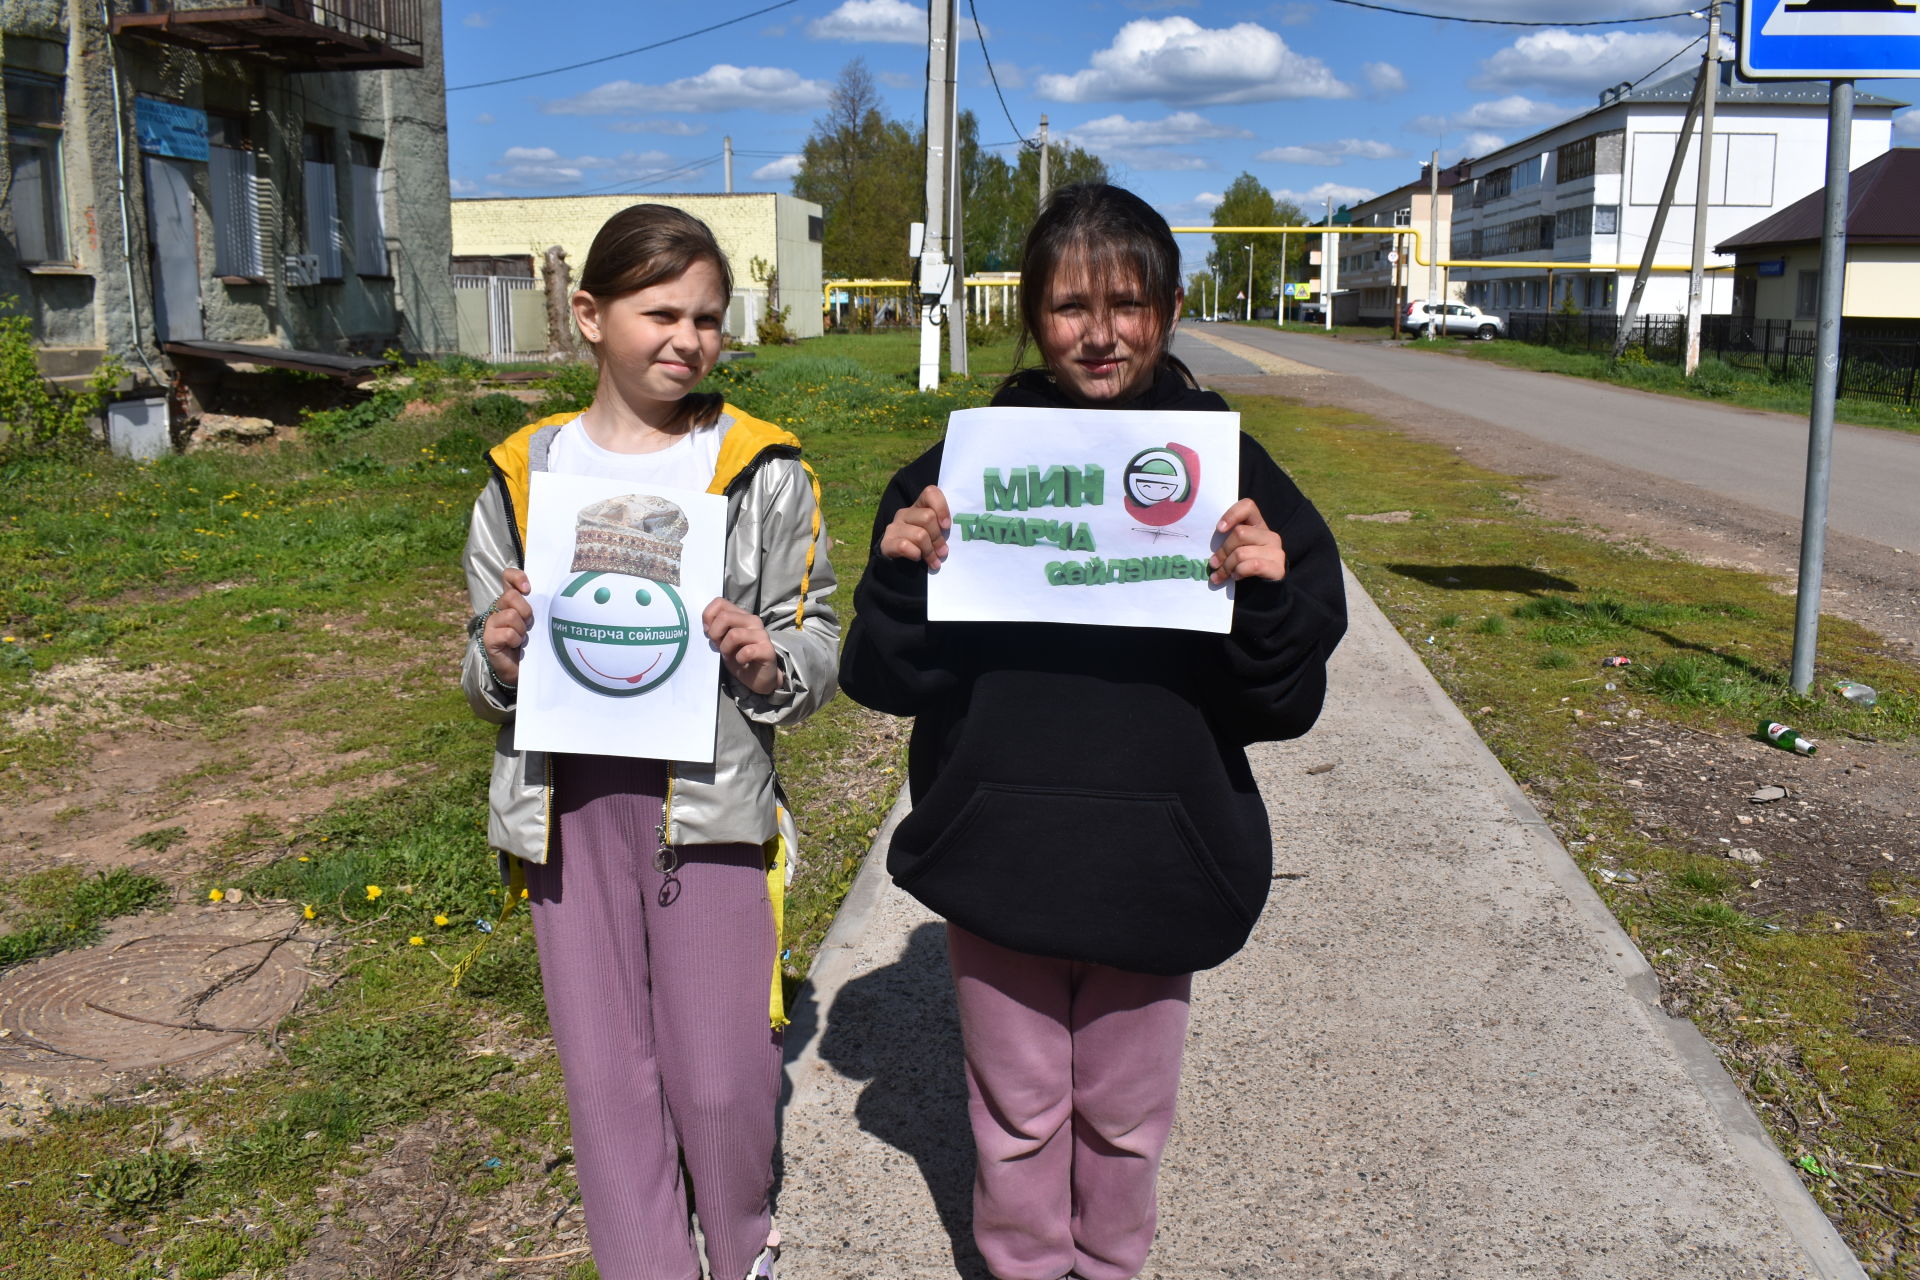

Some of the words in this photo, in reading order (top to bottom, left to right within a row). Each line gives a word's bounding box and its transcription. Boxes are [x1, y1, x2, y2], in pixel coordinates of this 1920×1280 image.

[983, 464, 1104, 511] МИН
[953, 513, 1096, 552] ТАТАРЧА
[570, 625, 624, 641] татарча
